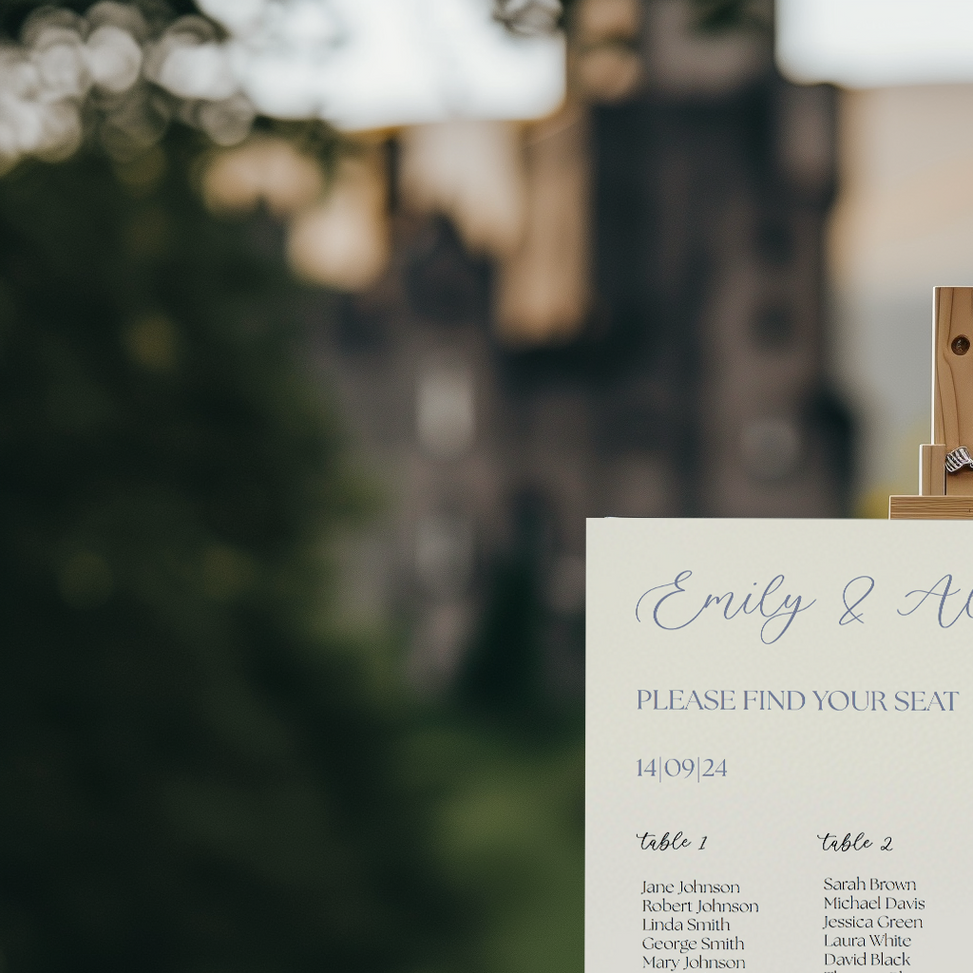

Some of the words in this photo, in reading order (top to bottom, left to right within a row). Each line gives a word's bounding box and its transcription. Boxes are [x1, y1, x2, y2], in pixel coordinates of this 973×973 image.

[635, 570, 817, 645] Emily
[839, 576, 874, 626] &
[637, 690, 736, 710] PLEASE
[743, 690, 805, 710] FIND
[812, 690, 888, 711] YOUR
[895, 691, 960, 711] SEAT
[636, 831, 692, 851] table
[698, 836, 707, 850] 1
[817, 832, 873, 852] table
[880, 836, 893, 851] 2
[641, 881, 674, 895] Jane
[677, 879, 740, 895] Johnson
[824, 876, 866, 891] Sarah
[870, 878, 916, 891] Brown
[643, 898, 693, 912] Robert
[696, 898, 759, 914] Johnson
[824, 895, 881, 910] Michael
[886, 897, 925, 910] Davis
[643, 917, 683, 931] Linda
[687, 917, 730, 931] Smith
[822, 916, 873, 930] Jessica
[877, 915, 923, 929] Green
[642, 937, 697, 954] George
[700, 936, 744, 951] Smith
[825, 934, 866, 947] Laura
[869, 933, 911, 947] White
[643, 956, 680, 971] Mary
[682, 955, 745, 970] Johnson
[825, 952, 866, 966] David
[871, 952, 911, 966] Black
